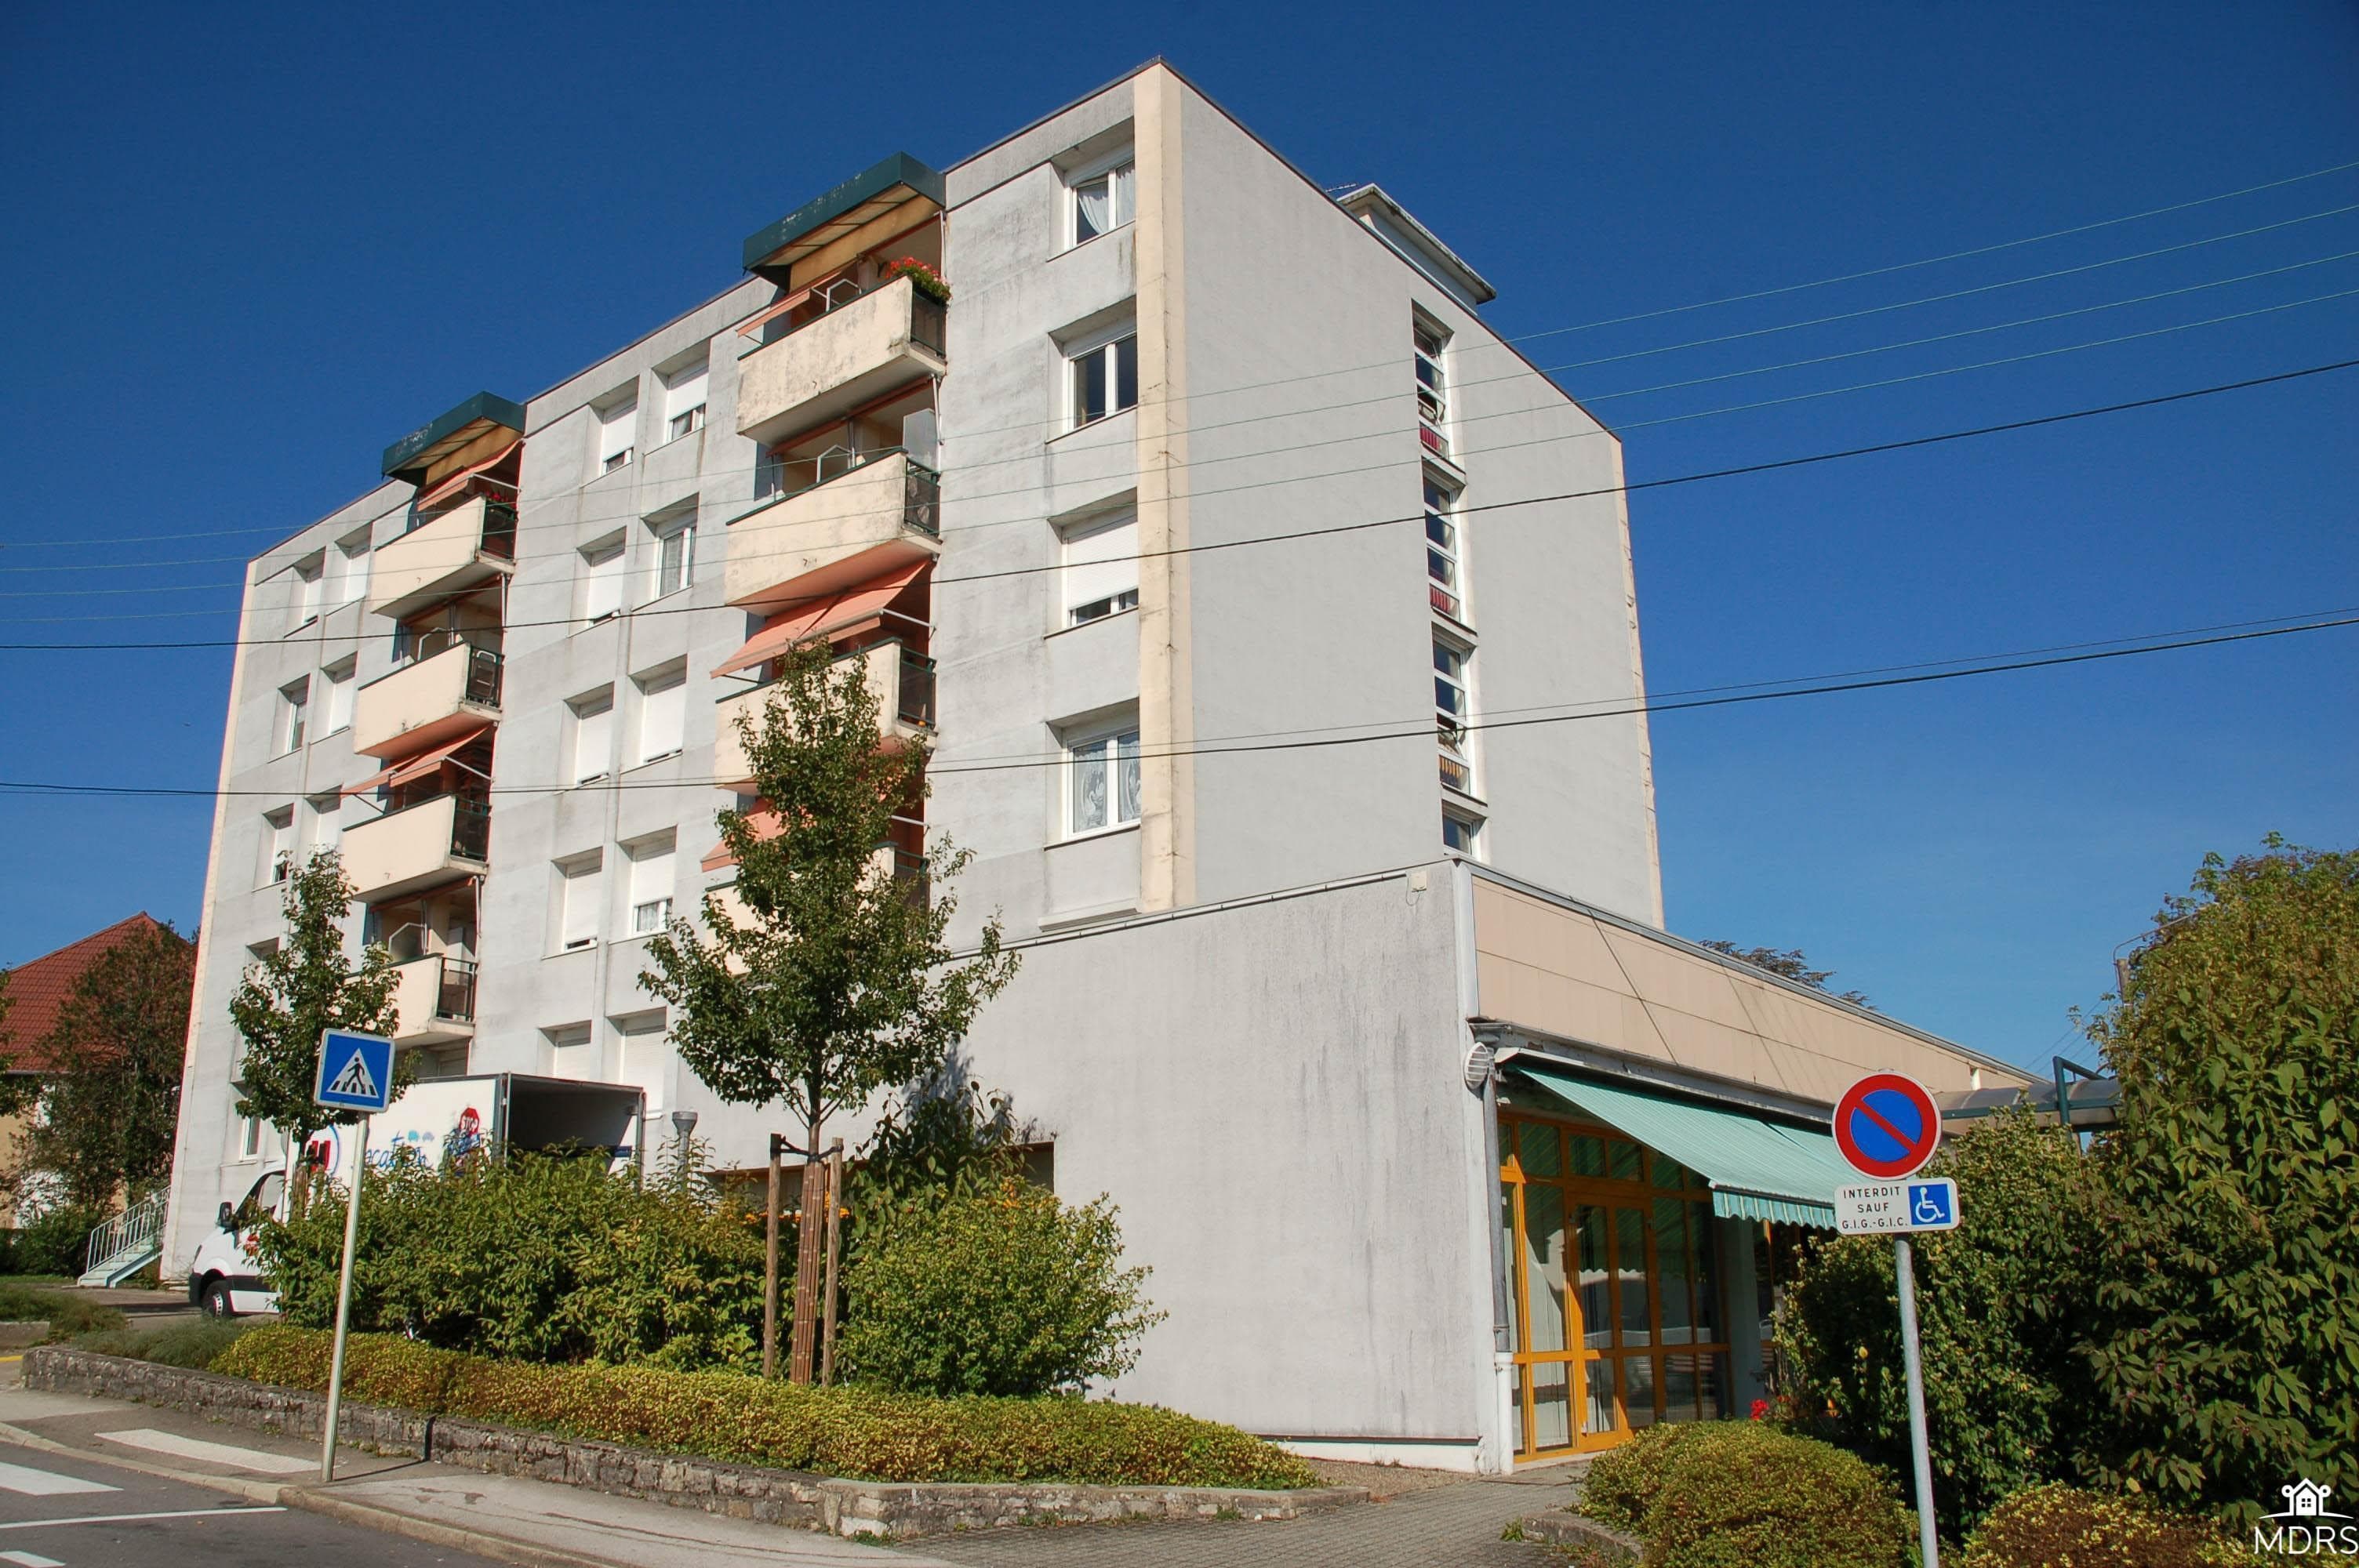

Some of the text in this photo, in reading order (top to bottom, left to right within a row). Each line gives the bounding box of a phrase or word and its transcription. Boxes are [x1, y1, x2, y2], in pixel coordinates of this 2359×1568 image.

[1843, 1186, 1899, 1199] INTERDIT
[1857, 1202, 1889, 1213] SAUF
[1841, 1217, 1908, 1229] G.I.G.-G.I.C.
